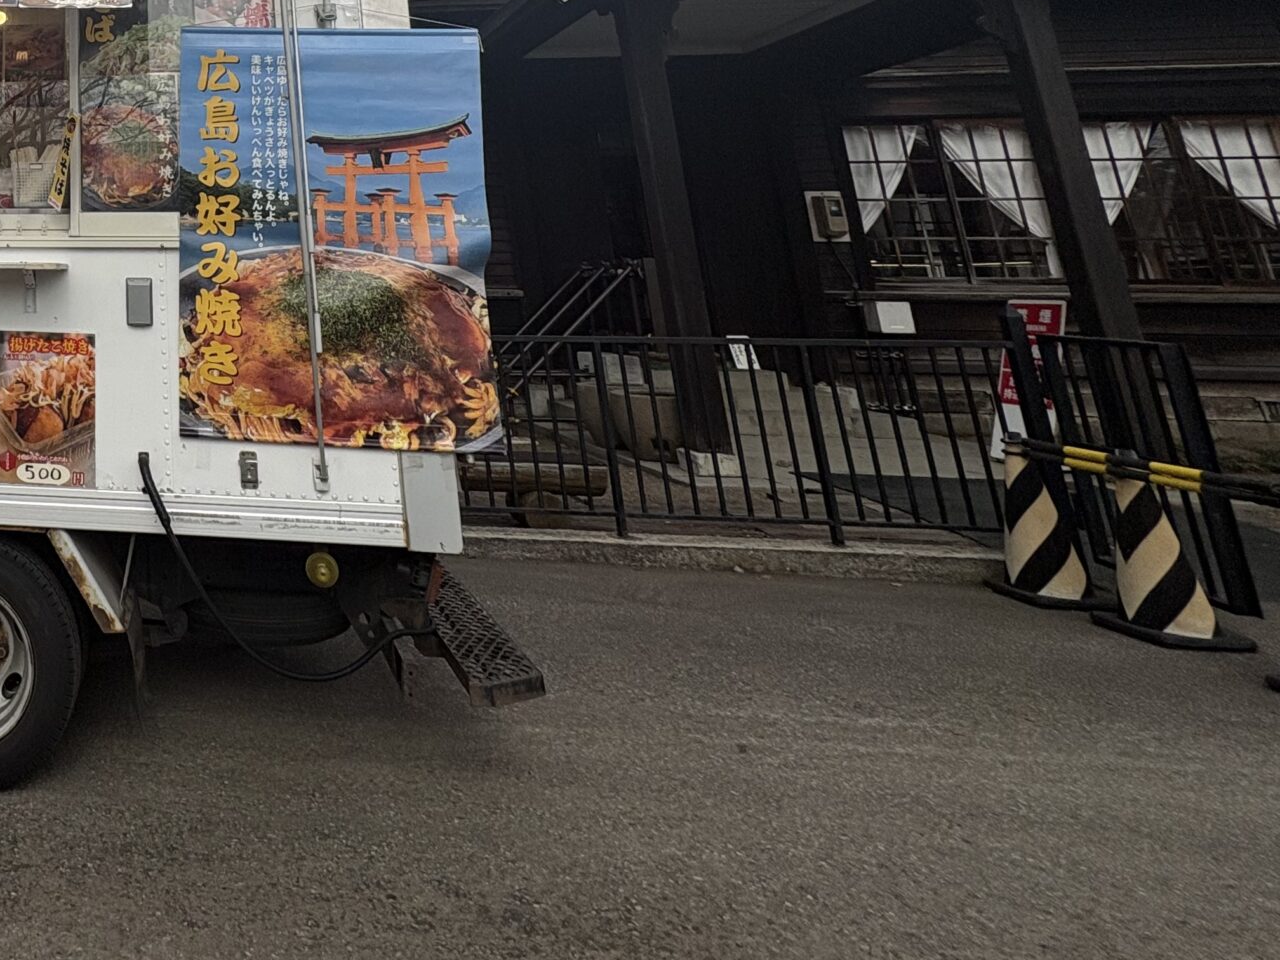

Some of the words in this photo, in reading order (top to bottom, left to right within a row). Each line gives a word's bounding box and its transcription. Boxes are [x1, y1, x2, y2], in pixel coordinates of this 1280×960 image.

[195, 49, 243, 385] 広島お好み焼き
[8, 336, 89, 355] 揚げたこ焼き
[25, 465, 61, 481] 500
